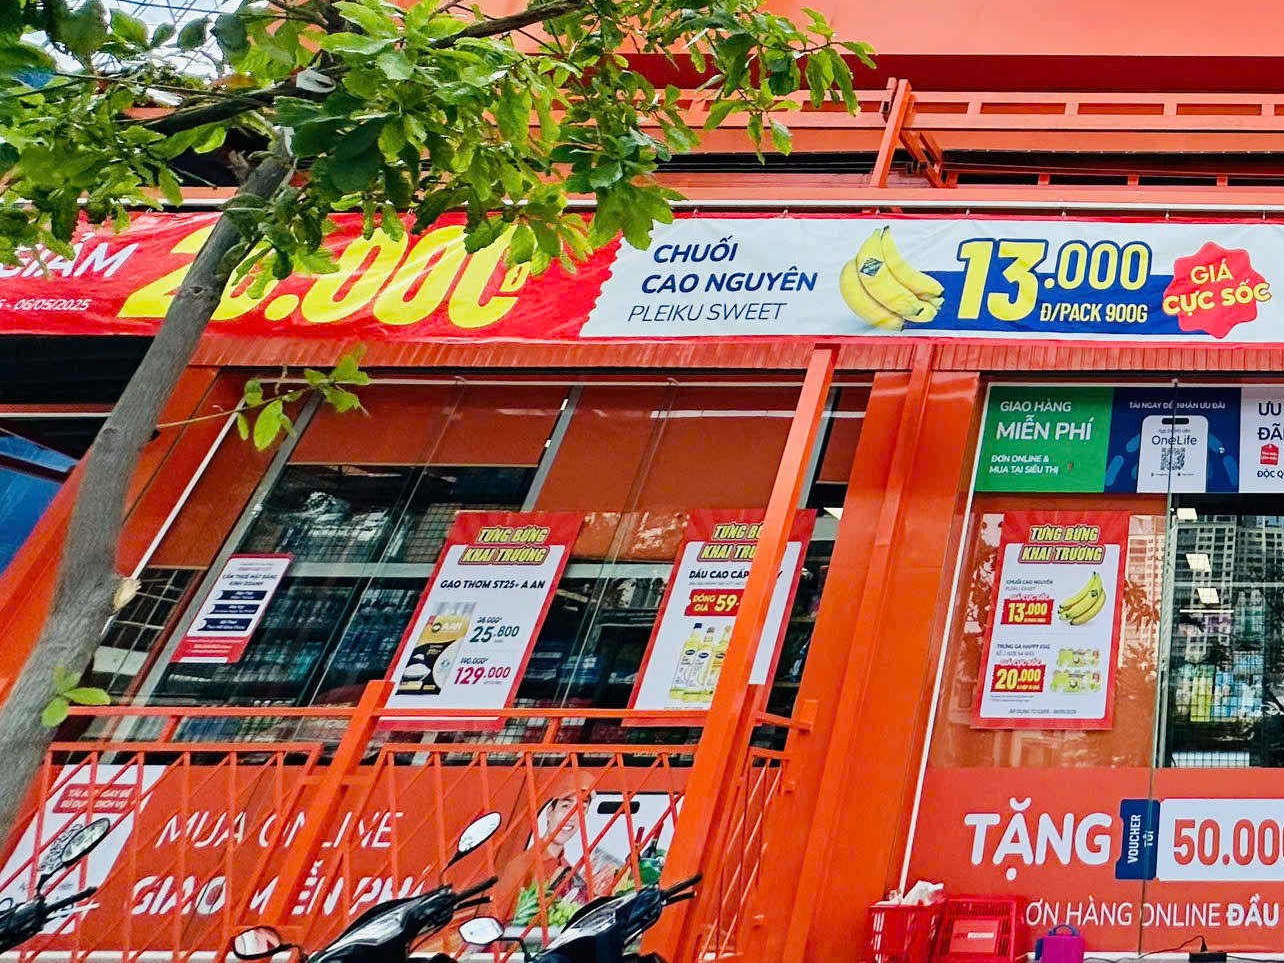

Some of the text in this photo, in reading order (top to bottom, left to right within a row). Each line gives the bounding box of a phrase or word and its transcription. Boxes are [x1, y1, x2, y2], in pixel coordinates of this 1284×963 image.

[653, 235, 738, 263] CHUỐI
[641, 266, 818, 294] CAO NGUYÊN
[1190, 258, 1234, 284] GIÁ
[957, 239, 1151, 322] 13.000
[14, 298, 93, 311] 06/05/2025
[1163, 279, 1273, 318] CỰC SỐC
[627, 302, 788, 322] PLEIKU SWEET
[1040, 303, 1148, 323] Đ/PACK 900G
[1000, 398, 1072, 412] GIAO HÀNG
[1141, 401, 1162, 409] NGAY
[1258, 400, 1281, 416] ƯU
[996, 414, 1094, 441] MIỄN PHÍ
[1152, 434, 1197, 445] OneLife
[1011, 454, 1042, 463] ONLINE
[989, 465, 1009, 474] MUA
[1257, 470, 1275, 480] ĐỘC
[463, 548, 494, 562] KHAI
[700, 545, 731, 558] KHAI
[1022, 546, 1052, 561] KHAI
[710, 571, 729, 579] CAO
[530, 580, 546, 589] AN
[715, 594, 740, 612] 59.
[1008, 602, 1048, 622] 13.000
[469, 625, 520, 643] 25.800
[454, 666, 511, 685] 129.000
[995, 668, 1042, 690] 20.000
[964, 797, 1113, 881] TẶNG
[1127, 814, 1142, 864] VOUCHER
[1021, 898, 1060, 926] ƠN
[1065, 895, 1133, 926] HÀNG
[1141, 902, 1221, 927] ONLINE
[1226, 893, 1280, 927] ĐẦU
